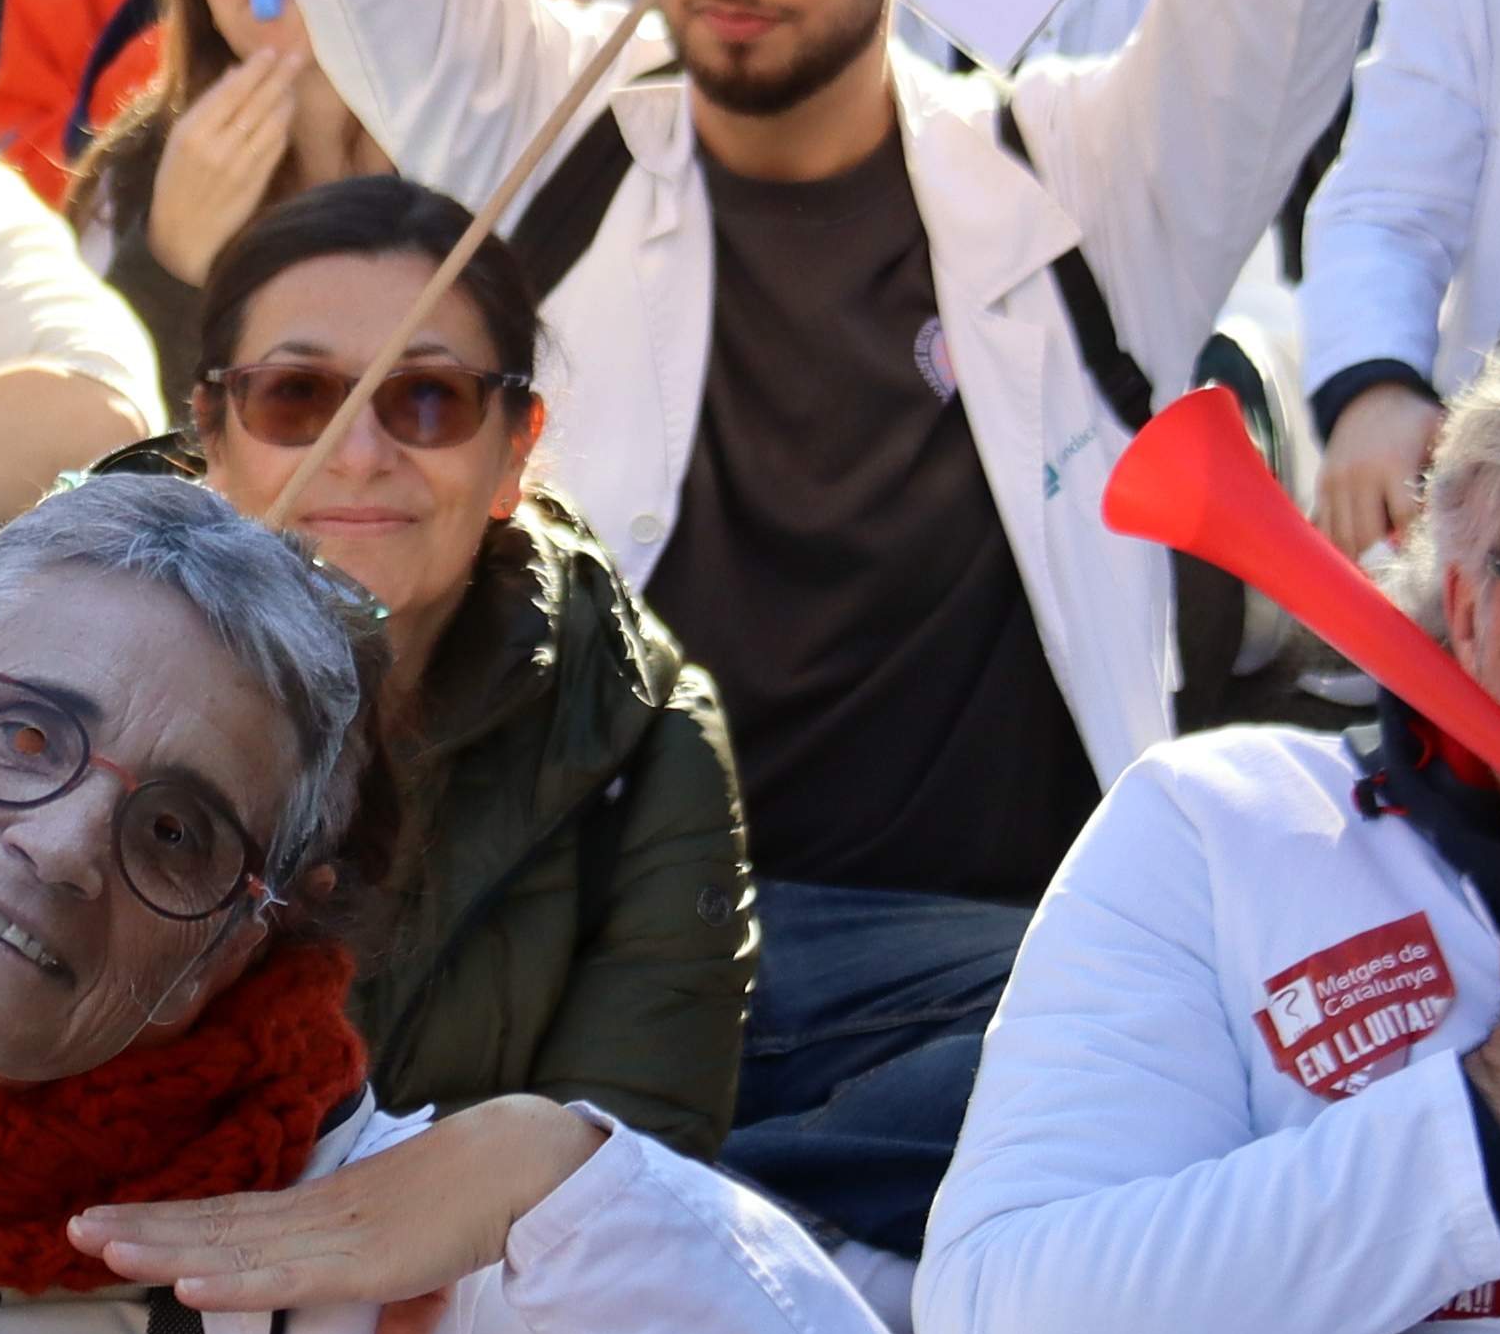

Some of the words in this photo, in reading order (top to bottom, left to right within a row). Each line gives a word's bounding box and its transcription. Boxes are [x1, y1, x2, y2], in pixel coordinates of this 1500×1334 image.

[1315, 953, 1397, 999] Metges
[1399, 943, 1429, 964] de
[1323, 965, 1437, 1017] Catalunya
[1294, 1041, 1338, 1088] EN
